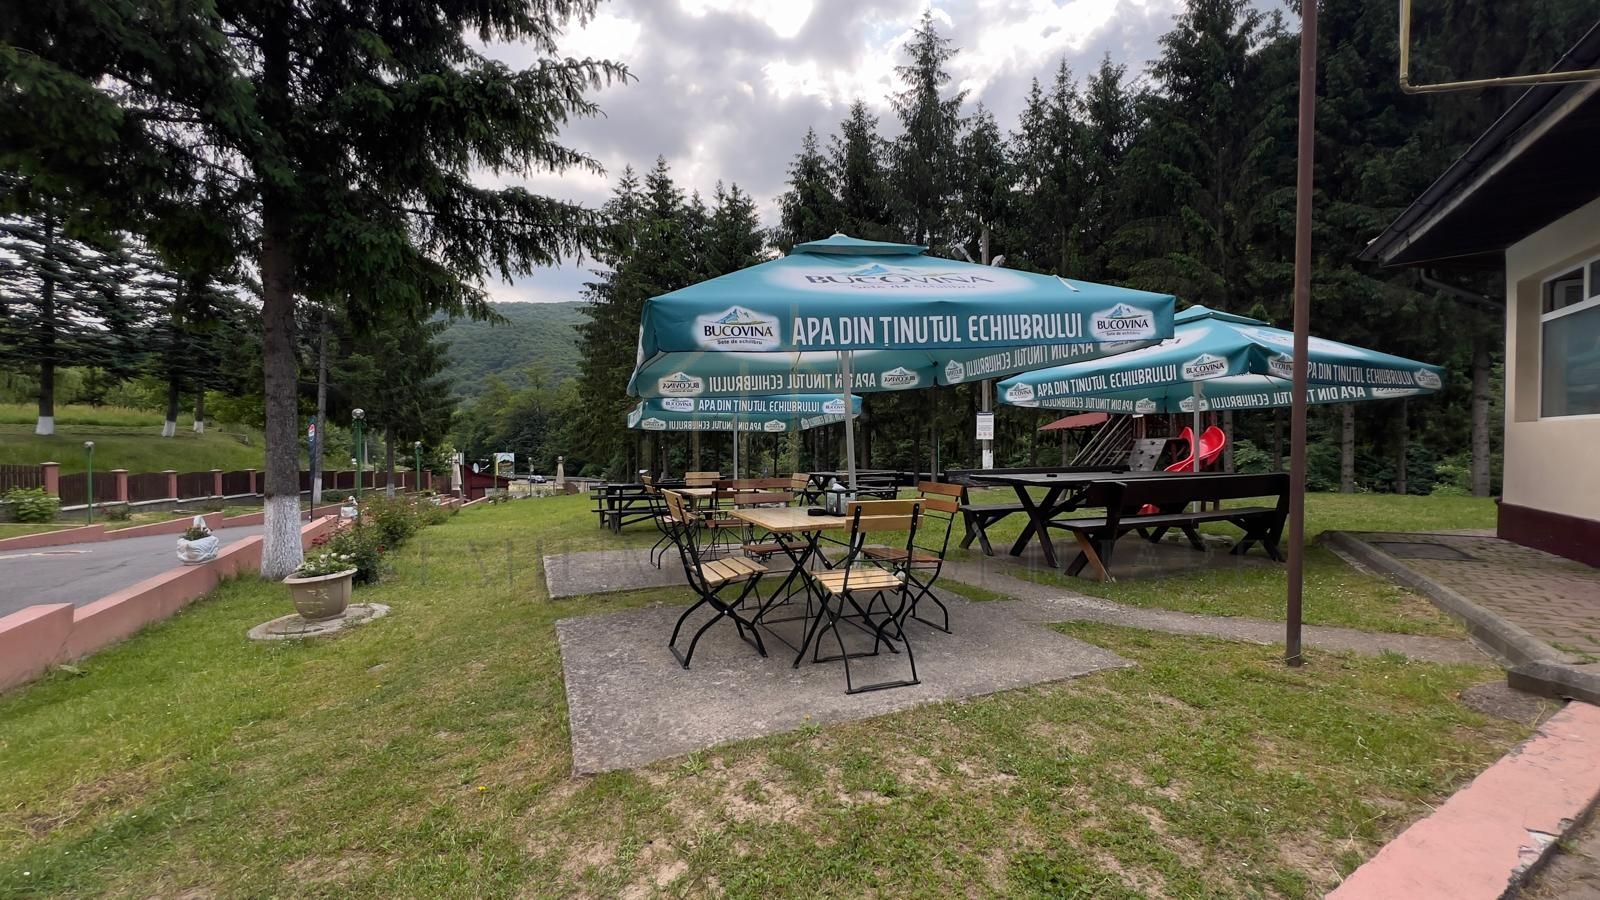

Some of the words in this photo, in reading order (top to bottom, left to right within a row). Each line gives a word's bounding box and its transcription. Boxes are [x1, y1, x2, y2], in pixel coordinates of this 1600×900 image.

[804, 275, 995, 284] BUCOVINA
[792, 317, 835, 346] APA
[839, 316, 875, 345] DIN
[968, 313, 1083, 342] ECHILIBRULUI
[1097, 319, 1149, 330] BUCOVINA
[704, 325, 773, 337] BUCOVINA
[1185, 362, 1225, 374] BUCOVINA
[1307, 362, 1317, 379] PA
[1318, 363, 1332, 380] DIN
[1366, 367, 1415, 385] ECHILIBRULUI
[1037, 383, 1053, 397] APA
[1055, 381, 1069, 394] DIN
[1110, 364, 1177, 388] ECHILIBRULUI
[699, 400, 716, 411] APA
[717, 400, 731, 411] DIN
[769, 400, 820, 412] ECHILIBRULUI
